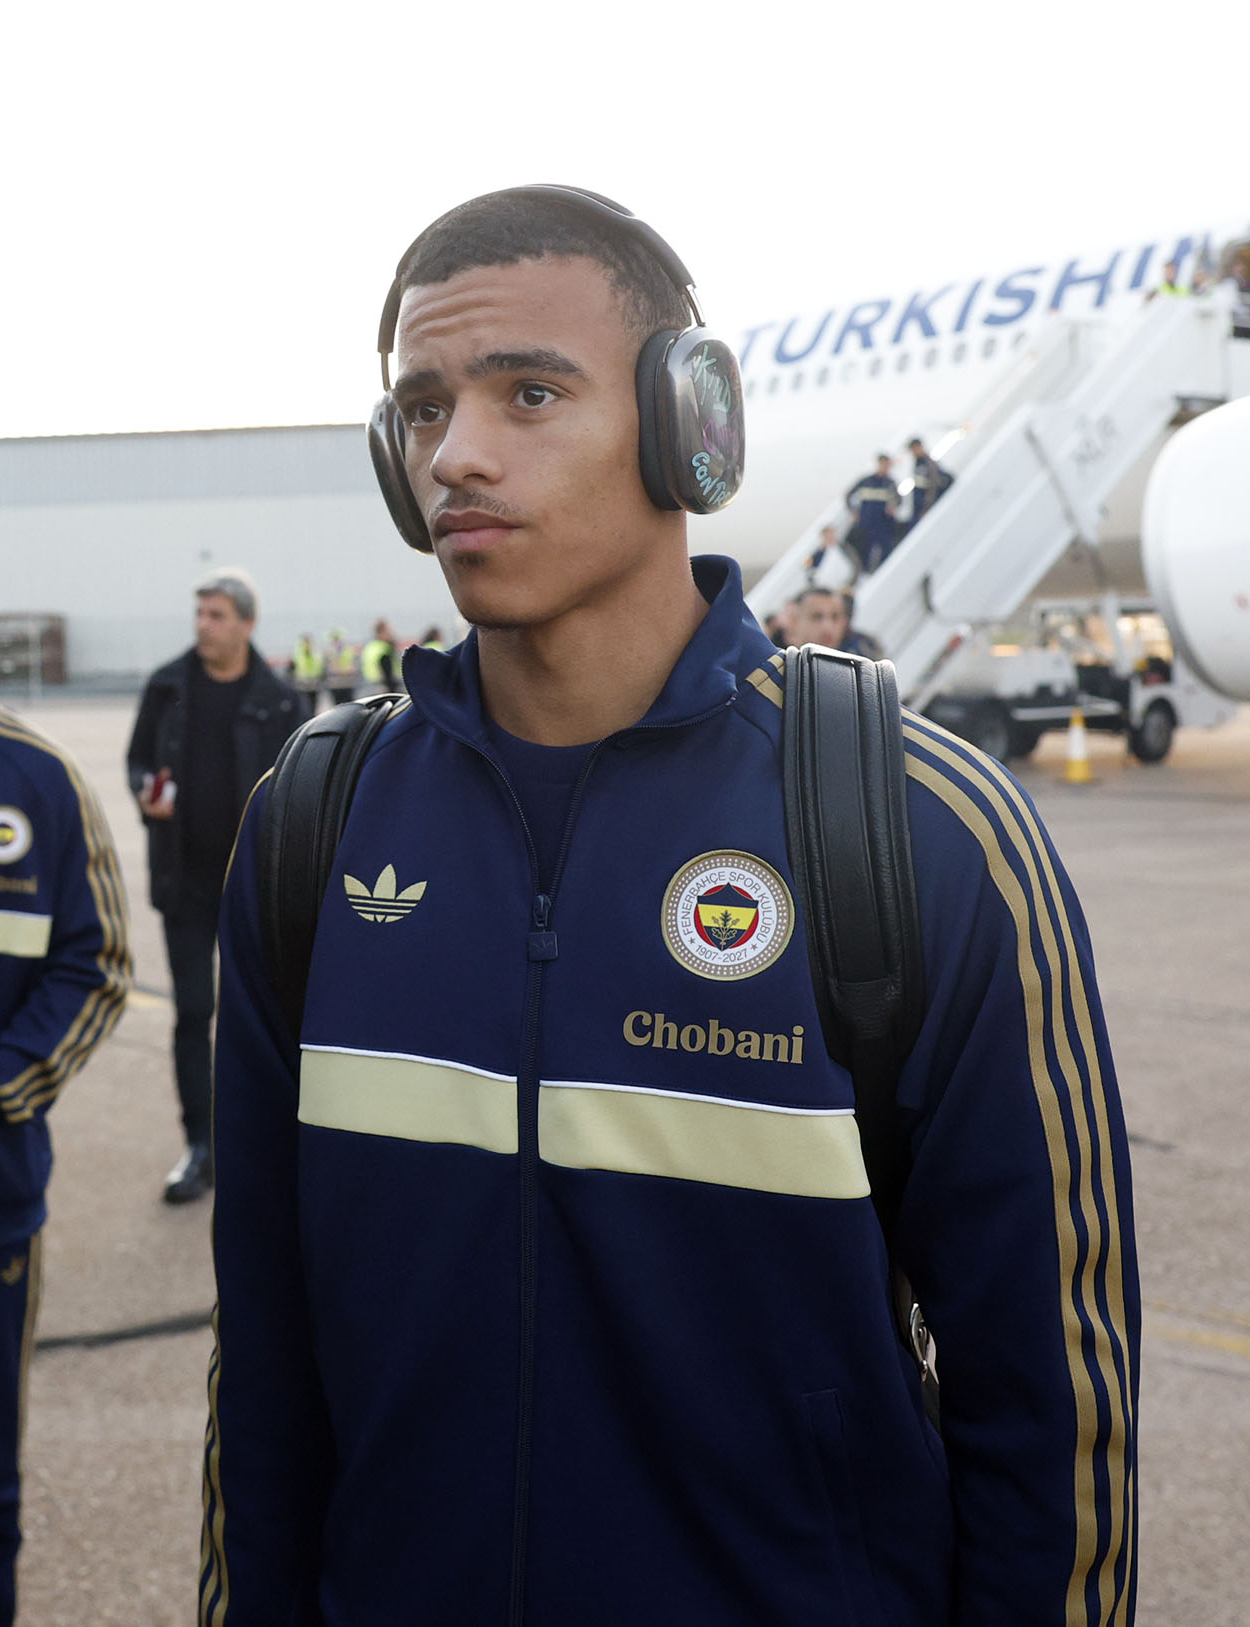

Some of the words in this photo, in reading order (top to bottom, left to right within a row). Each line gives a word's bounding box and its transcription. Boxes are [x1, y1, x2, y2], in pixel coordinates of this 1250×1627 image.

[683, 870, 727, 936] FENERBAHÇE
[728, 871, 761, 894] SPOR
[756, 892, 774, 944] KULÜBÜ
[695, 943, 749, 964] 1907-2027
[622, 1009, 805, 1065] Chobani
